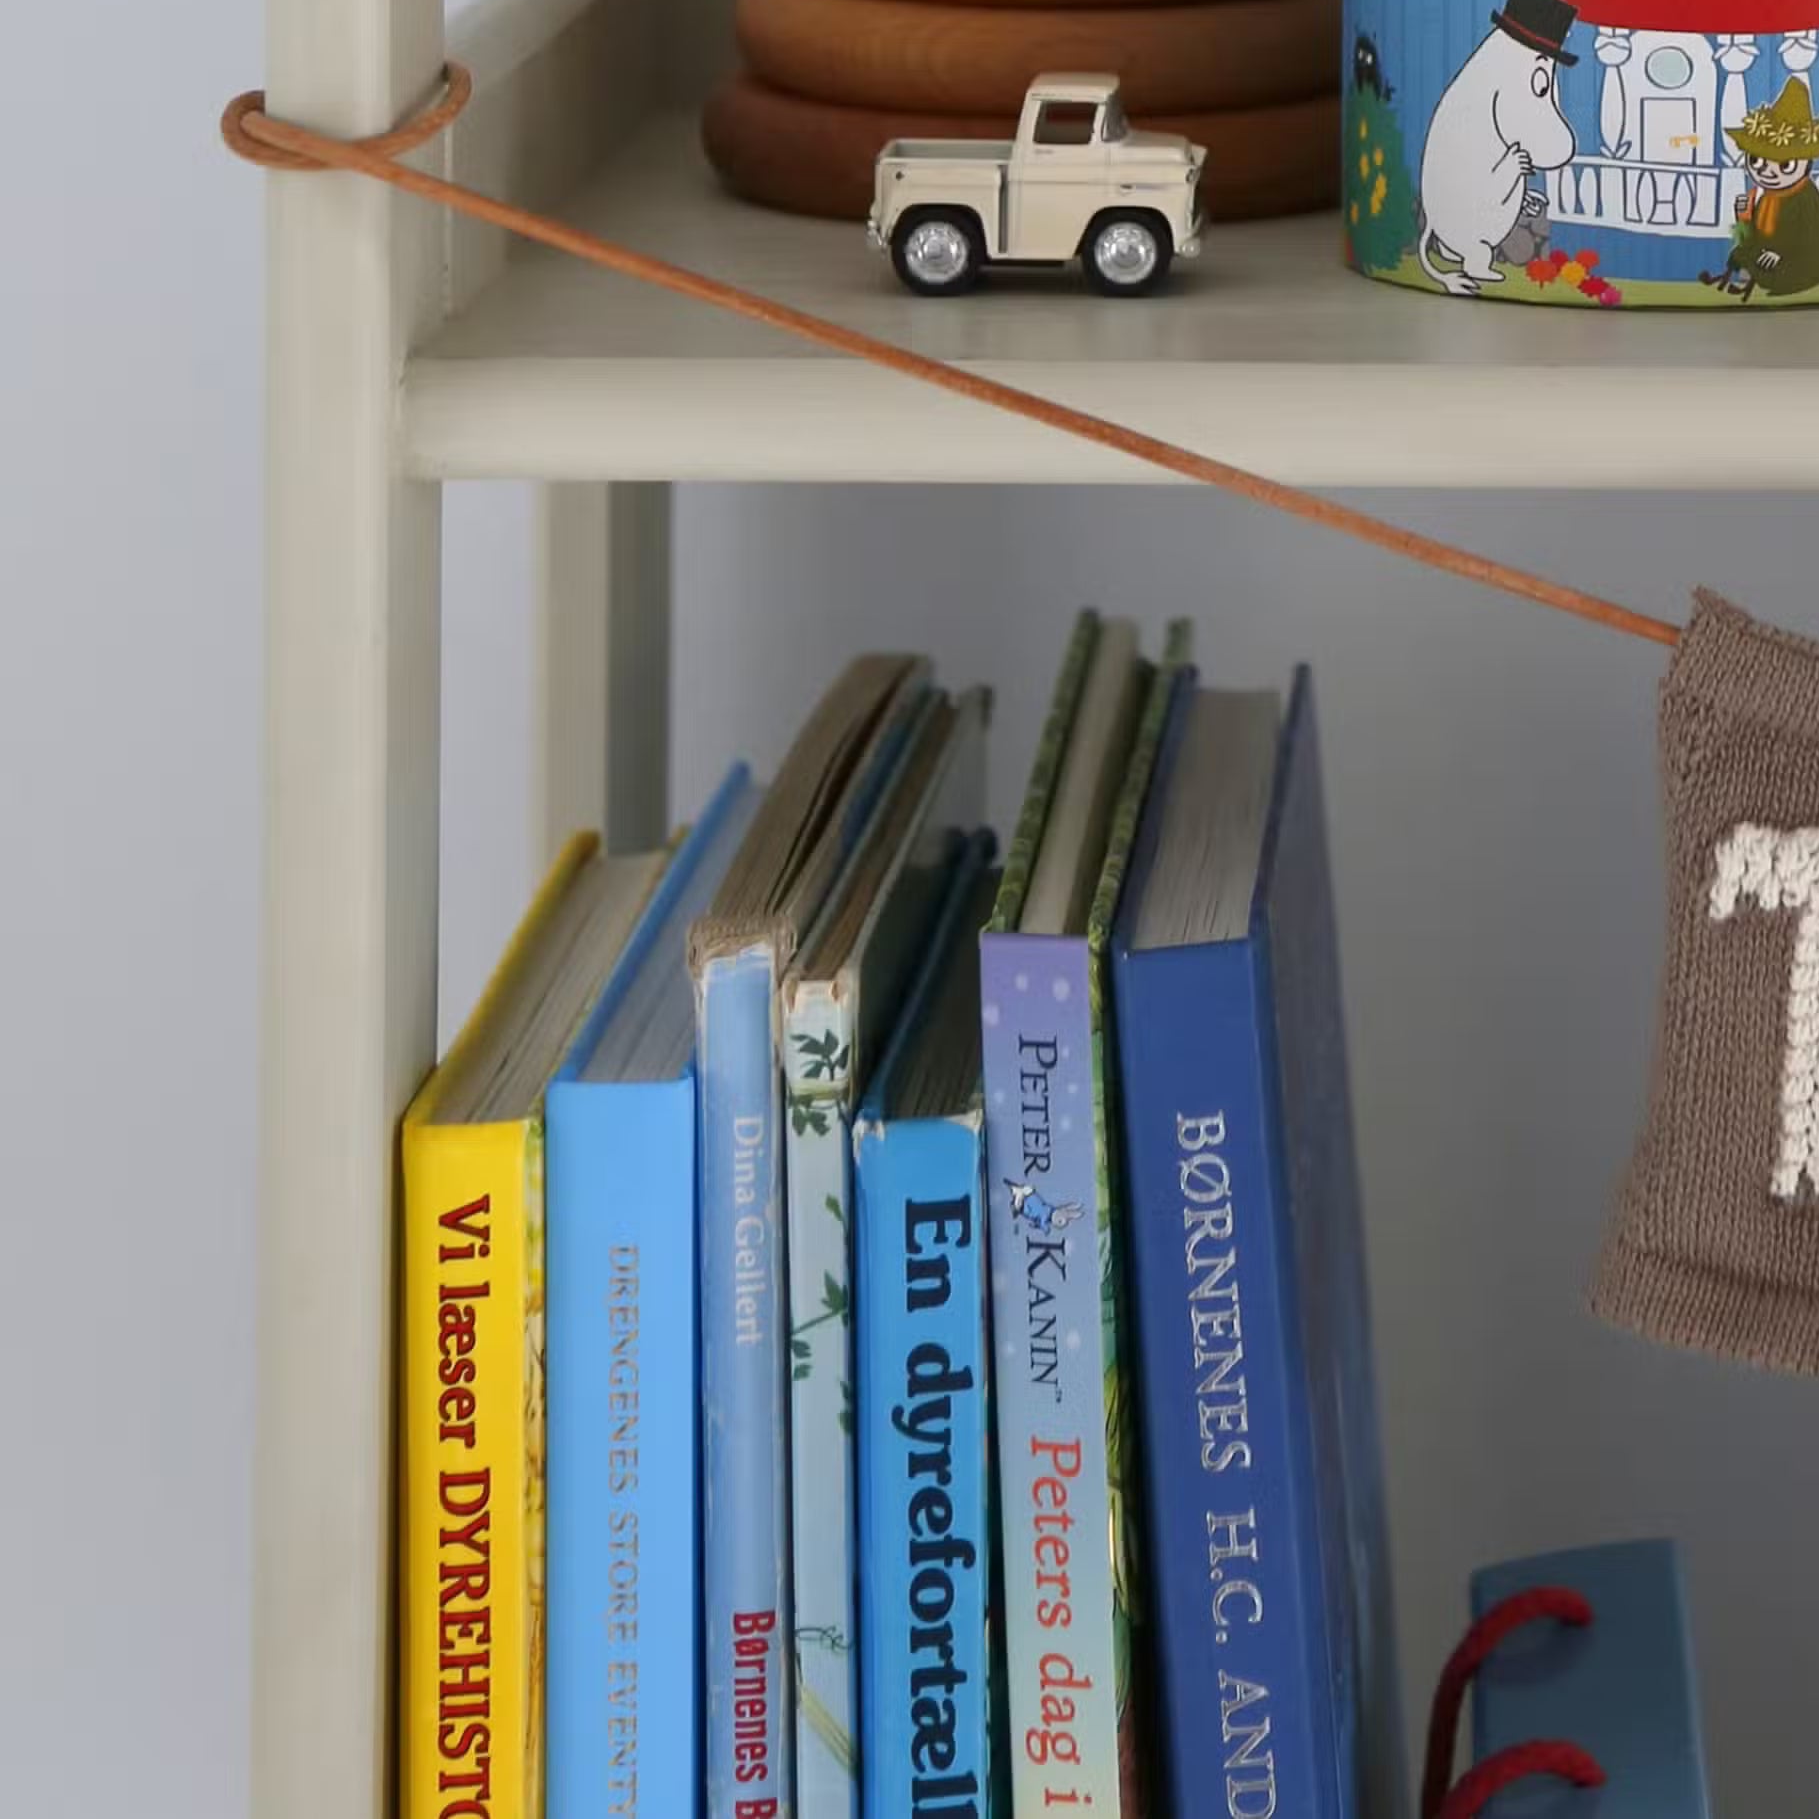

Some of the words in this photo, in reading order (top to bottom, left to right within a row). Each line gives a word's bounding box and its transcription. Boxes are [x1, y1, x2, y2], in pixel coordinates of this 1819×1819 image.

[734, 1116, 764, 1201] Dina
[1017, 1035, 1057, 1176] PETER
[438, 1194, 491, 1263] Vi
[735, 1216, 766, 1344] Gellert
[905, 1195, 972, 1312] En
[1177, 1110, 1252, 1472] BØRNENES
[438, 1282, 491, 1449] læser
[608, 1244, 639, 1494] DRENGENES
[608, 1511, 639, 1643] STORE
[1030, 1435, 1083, 1630] Peters
[1206, 1506, 1264, 1645] H.C.
[734, 1610, 776, 1783] Børnenes
[1025, 1652, 1093, 1765] dag
[1044, 1787, 1092, 1808] i
